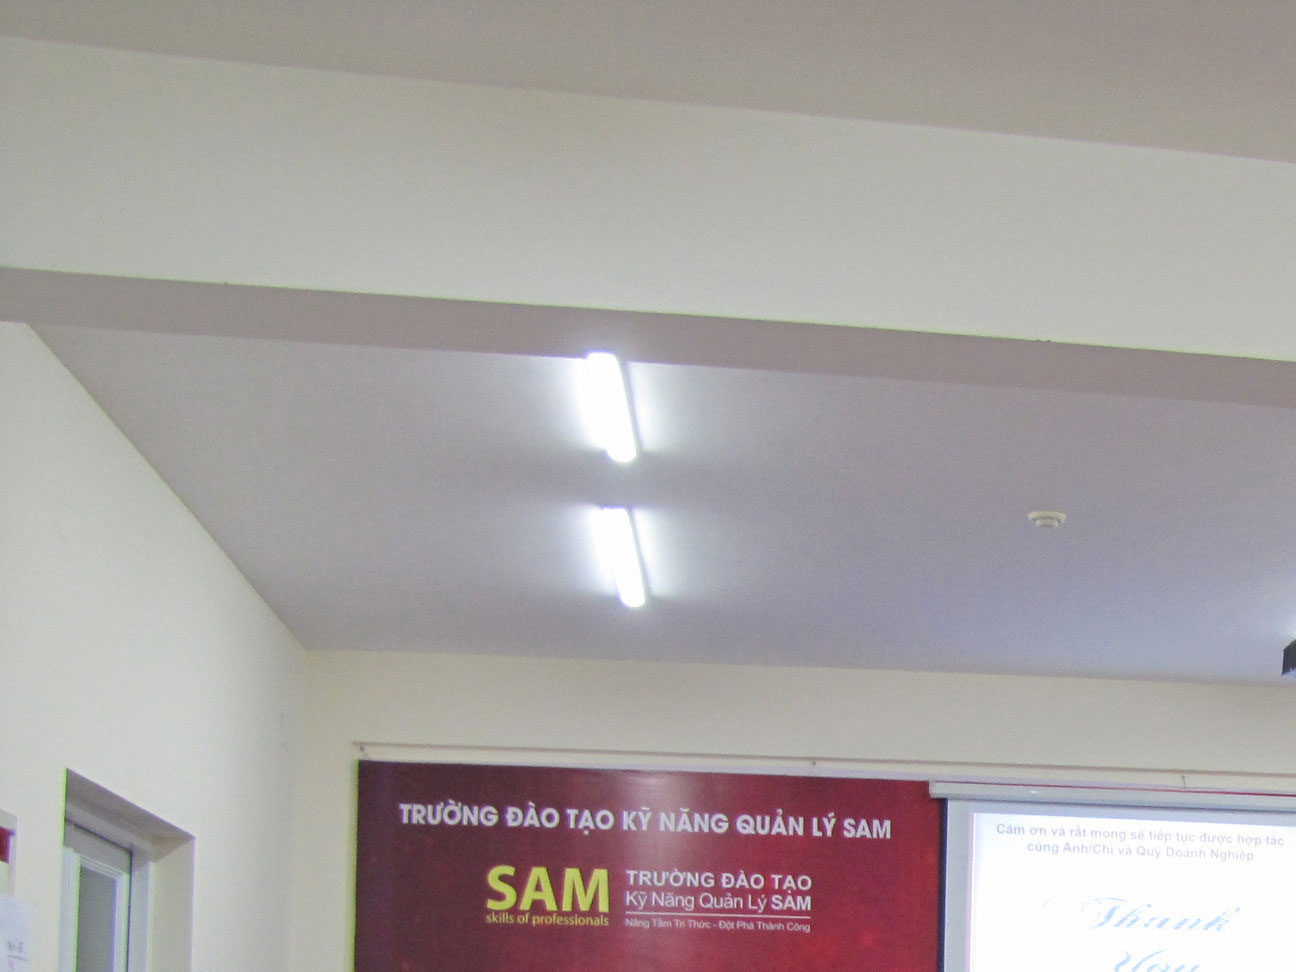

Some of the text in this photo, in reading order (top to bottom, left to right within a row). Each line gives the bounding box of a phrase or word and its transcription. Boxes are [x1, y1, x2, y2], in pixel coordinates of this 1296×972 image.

[399, 799, 891, 840] TRƯỜNG ĐÀO TẠO KỸ NĂNG QUẢN LÝ SAM
[486, 864, 610, 913] SAM
[626, 868, 812, 894] TRƯỜNG ĐÀO TẠO
[625, 890, 812, 914] Kỹ Năng Quản Lý SAM
[1062, 895, 1241, 931] Thank
[486, 912, 610, 927] skills of professionals
